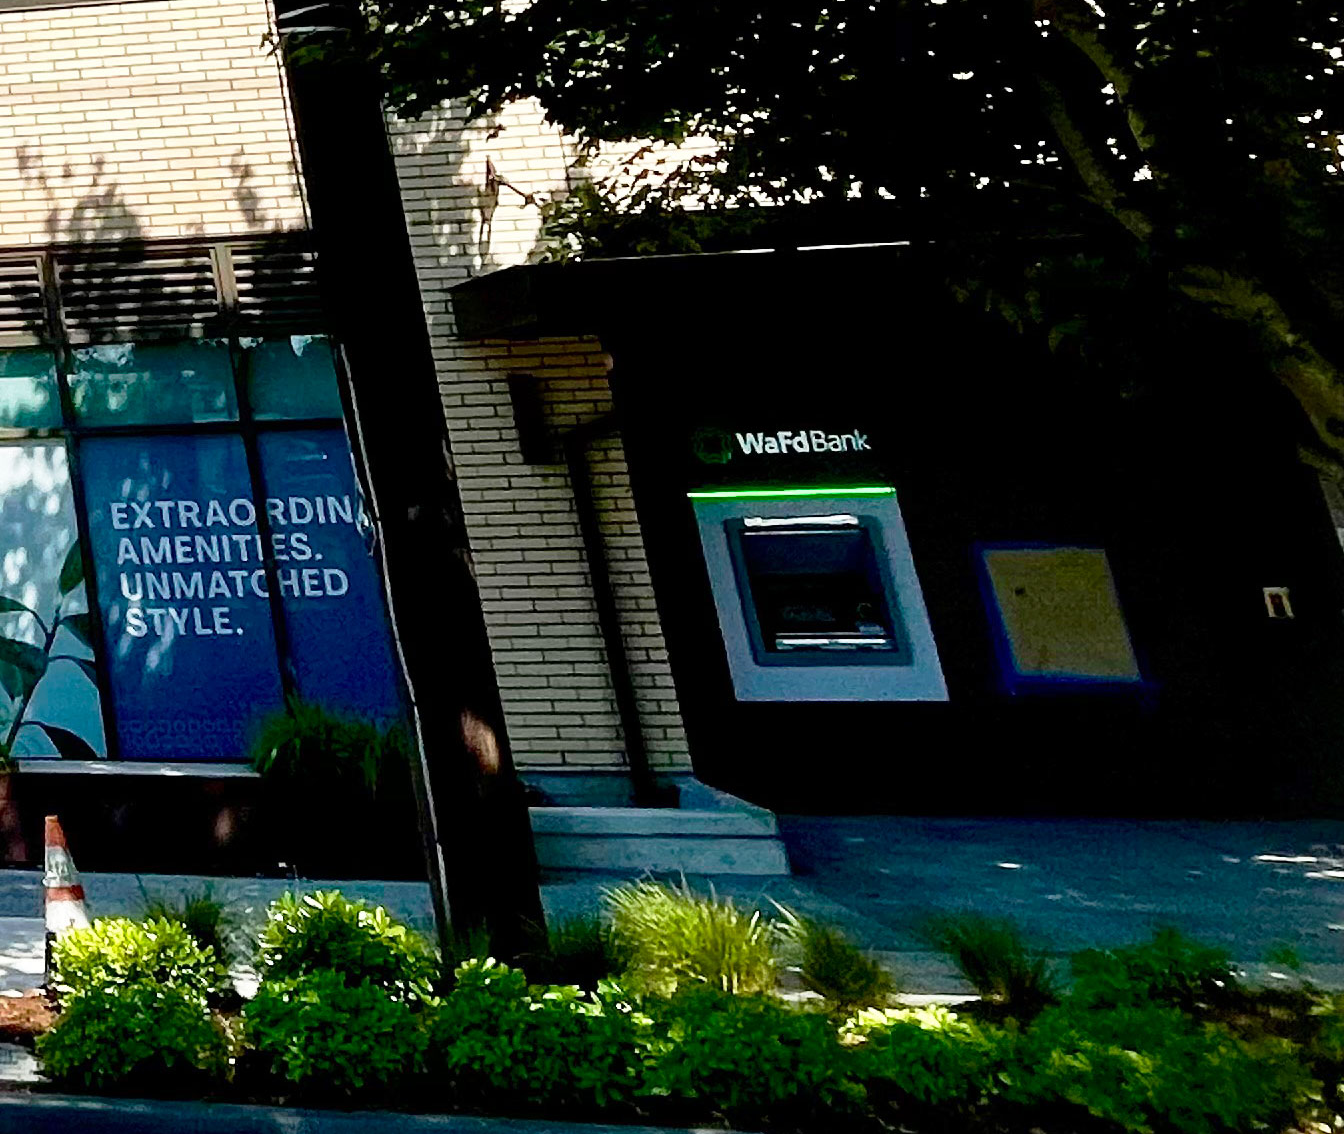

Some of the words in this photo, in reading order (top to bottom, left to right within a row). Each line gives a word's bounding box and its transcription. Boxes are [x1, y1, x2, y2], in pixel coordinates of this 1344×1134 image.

[110, 495, 354, 529] EXTRAORDIN
[117, 532, 323, 565] AMENITIES.
[119, 567, 350, 601] UNMATCHED
[125, 607, 243, 637] STYLE.
